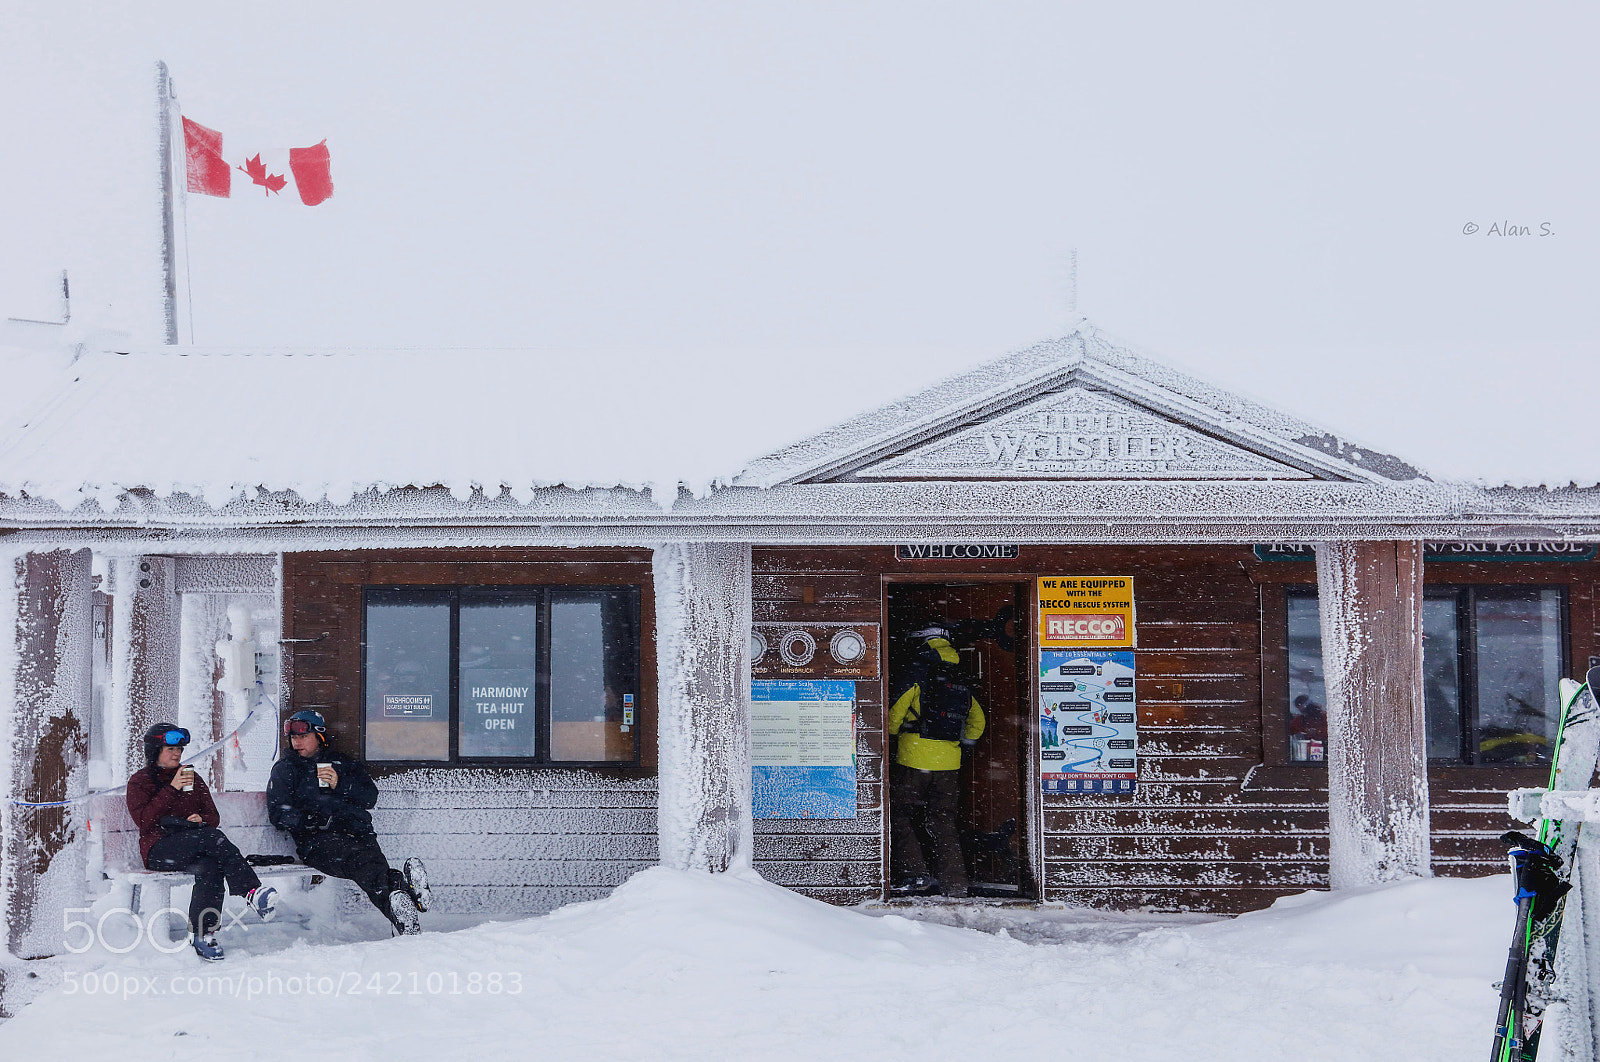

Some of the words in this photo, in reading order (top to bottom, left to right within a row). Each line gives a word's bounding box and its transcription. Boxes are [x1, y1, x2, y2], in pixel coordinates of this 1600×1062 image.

[907, 544, 1013, 558] WELCOME
[1043, 580, 1057, 588] WE
[1060, 580, 1078, 588] ARE
[1080, 580, 1126, 588] EQUIPPED
[1040, 599, 1071, 608] RECCO
[1048, 620, 1116, 635] RECCO
[472, 687, 529, 698] HARMONY
[476, 703, 497, 714] TEA
[501, 703, 524, 714] HUT
[485, 719, 515, 730] OPEN
